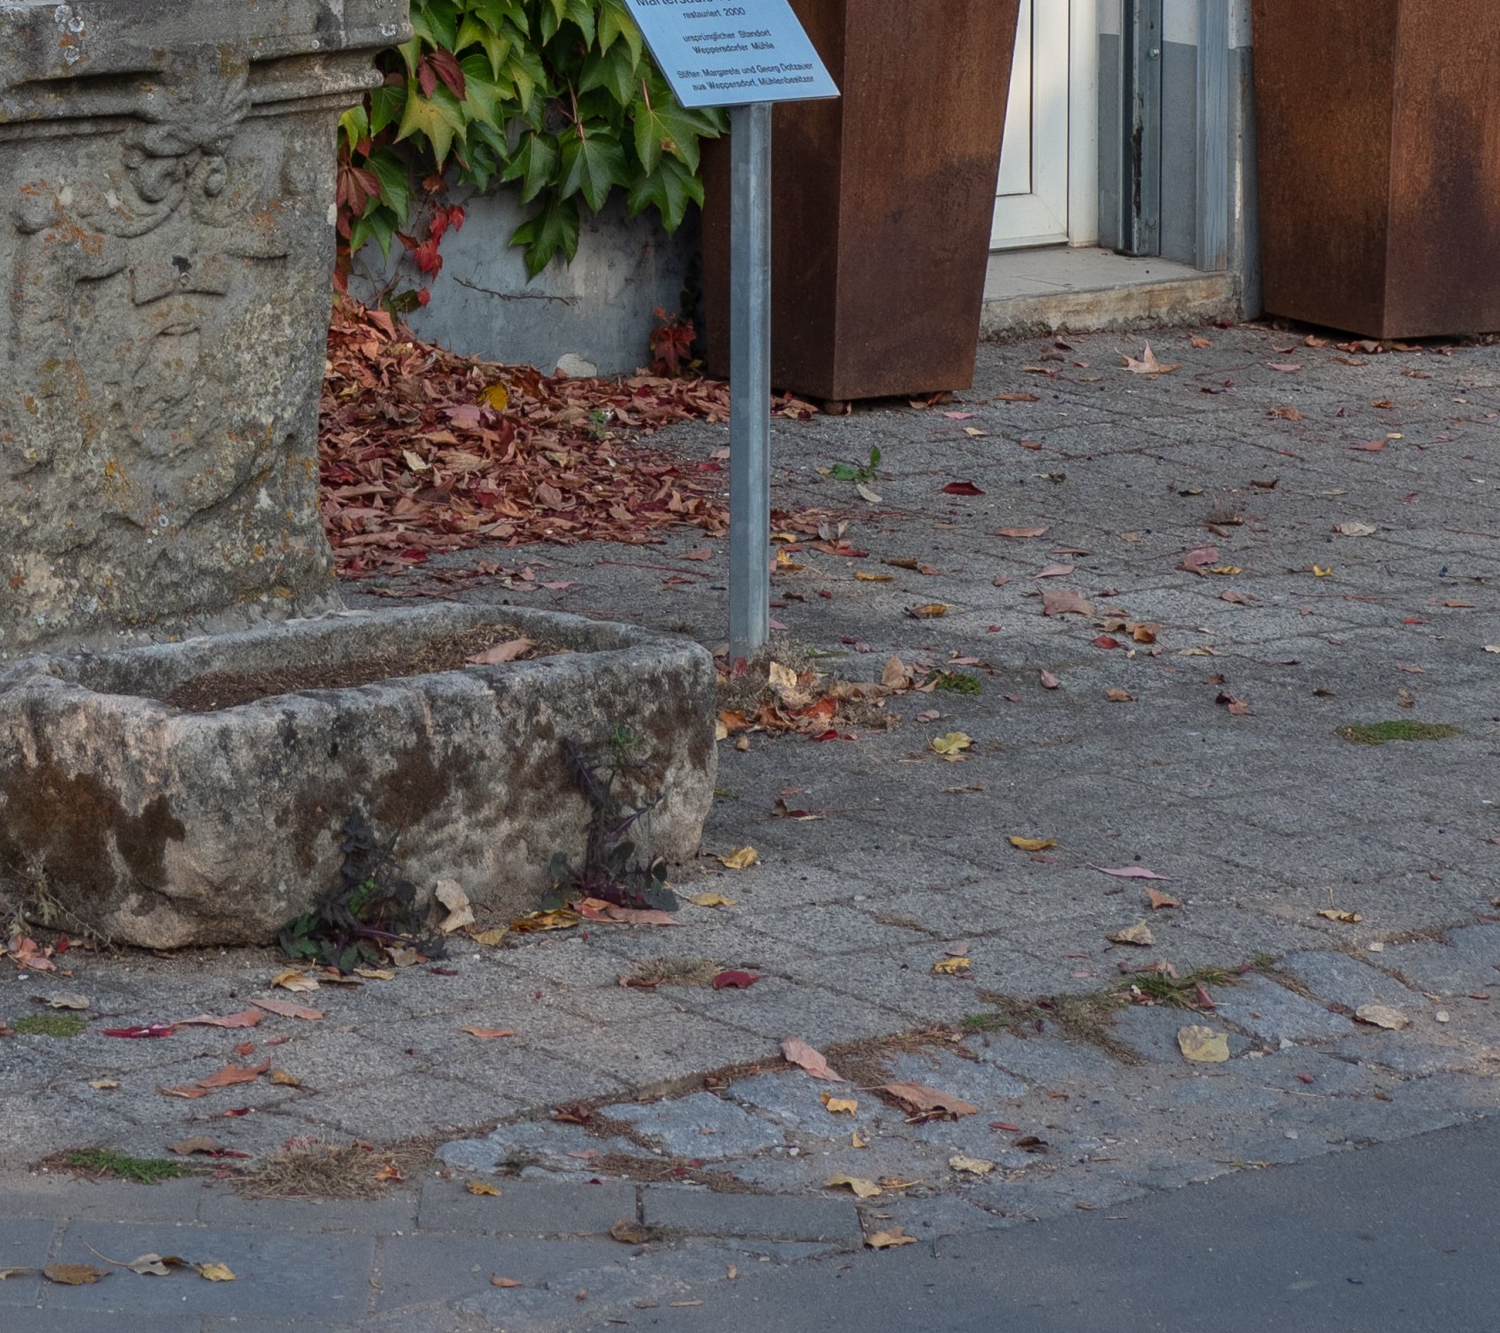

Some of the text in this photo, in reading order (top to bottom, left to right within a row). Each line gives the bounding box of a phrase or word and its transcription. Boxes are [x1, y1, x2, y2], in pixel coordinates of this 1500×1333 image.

[683, 7, 746, 19] restauriert 2000
[682, 29, 771, 42] ursprünglicher Standort
[692, 41, 775, 54] Weppersdorfer Mühle
[702, 67, 741, 77] Margarete
[741, 65, 756, 74] und
[756, 64, 781, 73] Georg
[780, 62, 813, 72] Dotzauer
